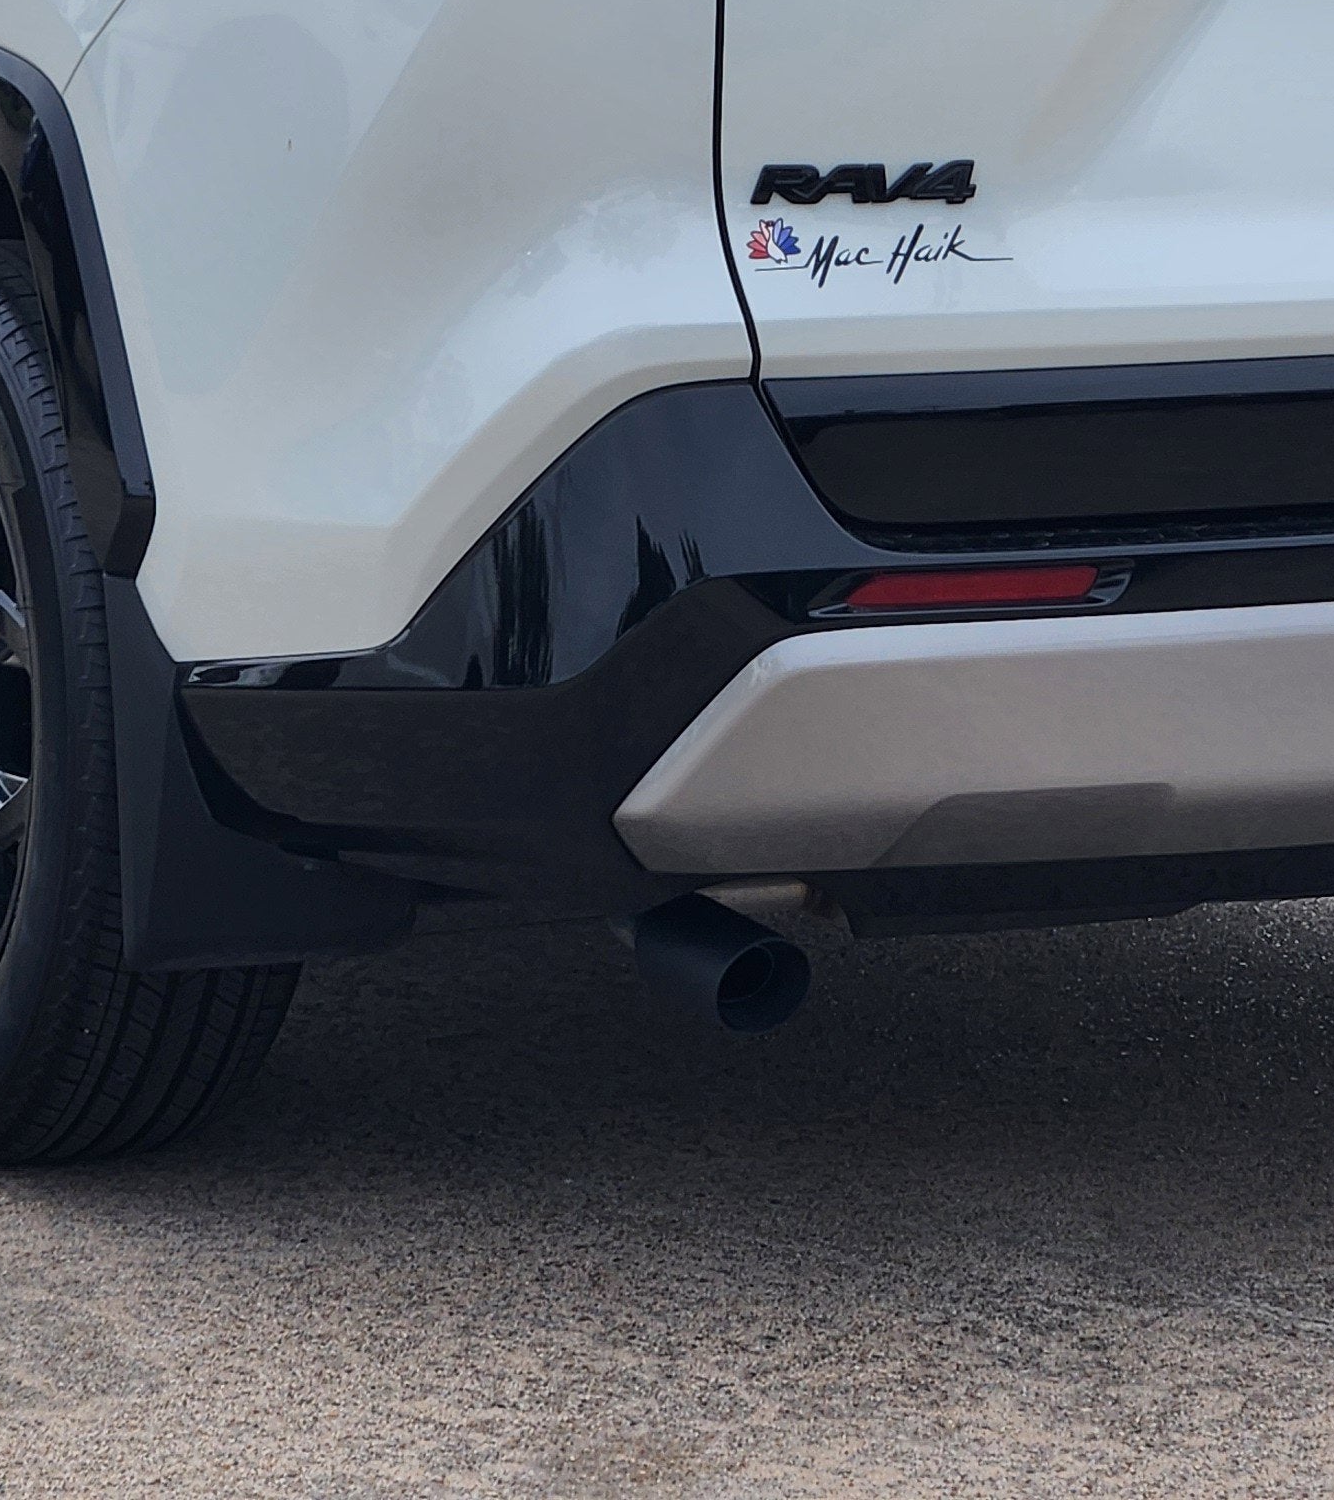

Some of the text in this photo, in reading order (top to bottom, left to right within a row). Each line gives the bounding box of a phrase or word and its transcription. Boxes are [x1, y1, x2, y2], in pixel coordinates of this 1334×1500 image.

[750, 159, 977, 205] RAV4
[797, 223, 994, 288] Mac Haik
